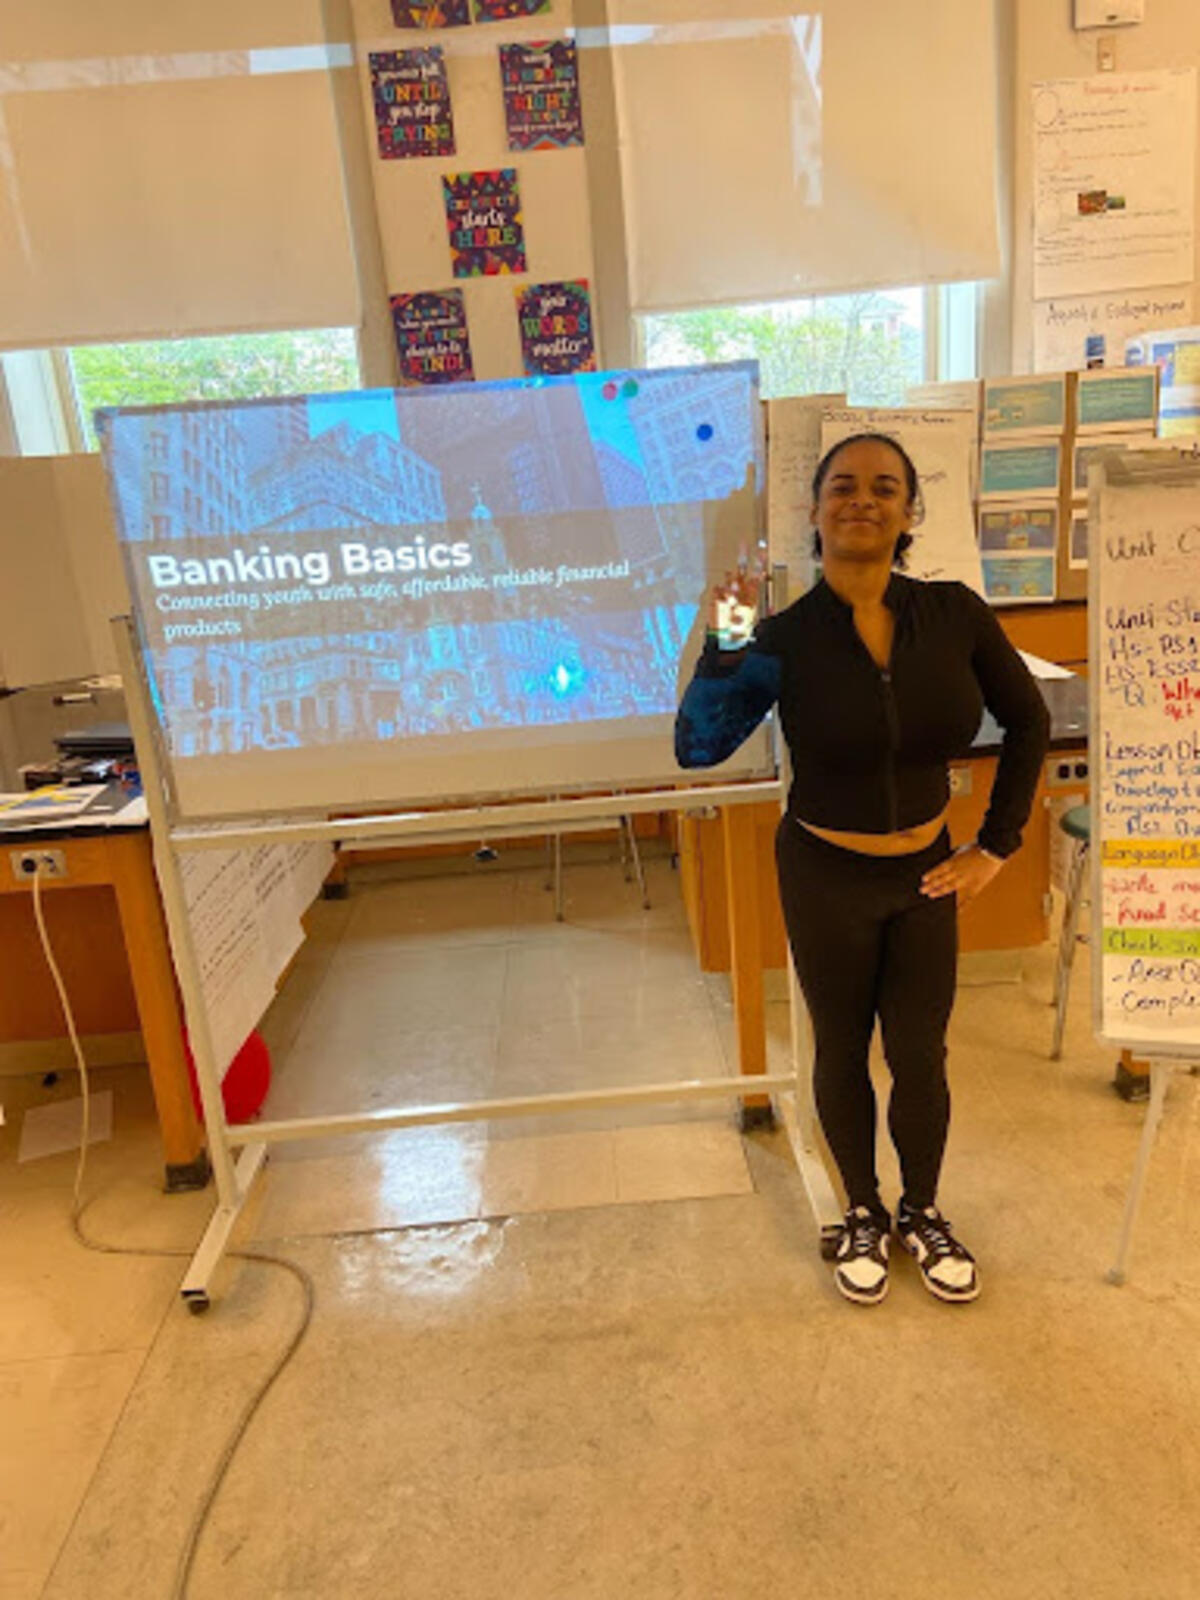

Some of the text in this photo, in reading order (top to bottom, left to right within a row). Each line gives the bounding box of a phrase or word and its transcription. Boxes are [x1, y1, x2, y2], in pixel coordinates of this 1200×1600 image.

[382, 81, 441, 104] UNTIL
[513, 91, 572, 113] RIGHT
[381, 123, 450, 144] TRYING
[461, 208, 506, 230] starts
[456, 227, 516, 249] HERE
[523, 312, 588, 338] WORDS
[148, 535, 472, 588] Banking Basics
[156, 590, 259, 611] Connecting
[262, 585, 313, 608] youth
[317, 582, 357, 601] with
[493, 567, 554, 588] reliable
[556, 560, 631, 588] financial
[163, 618, 242, 643] products
[1105, 731, 1174, 761] Lesson
